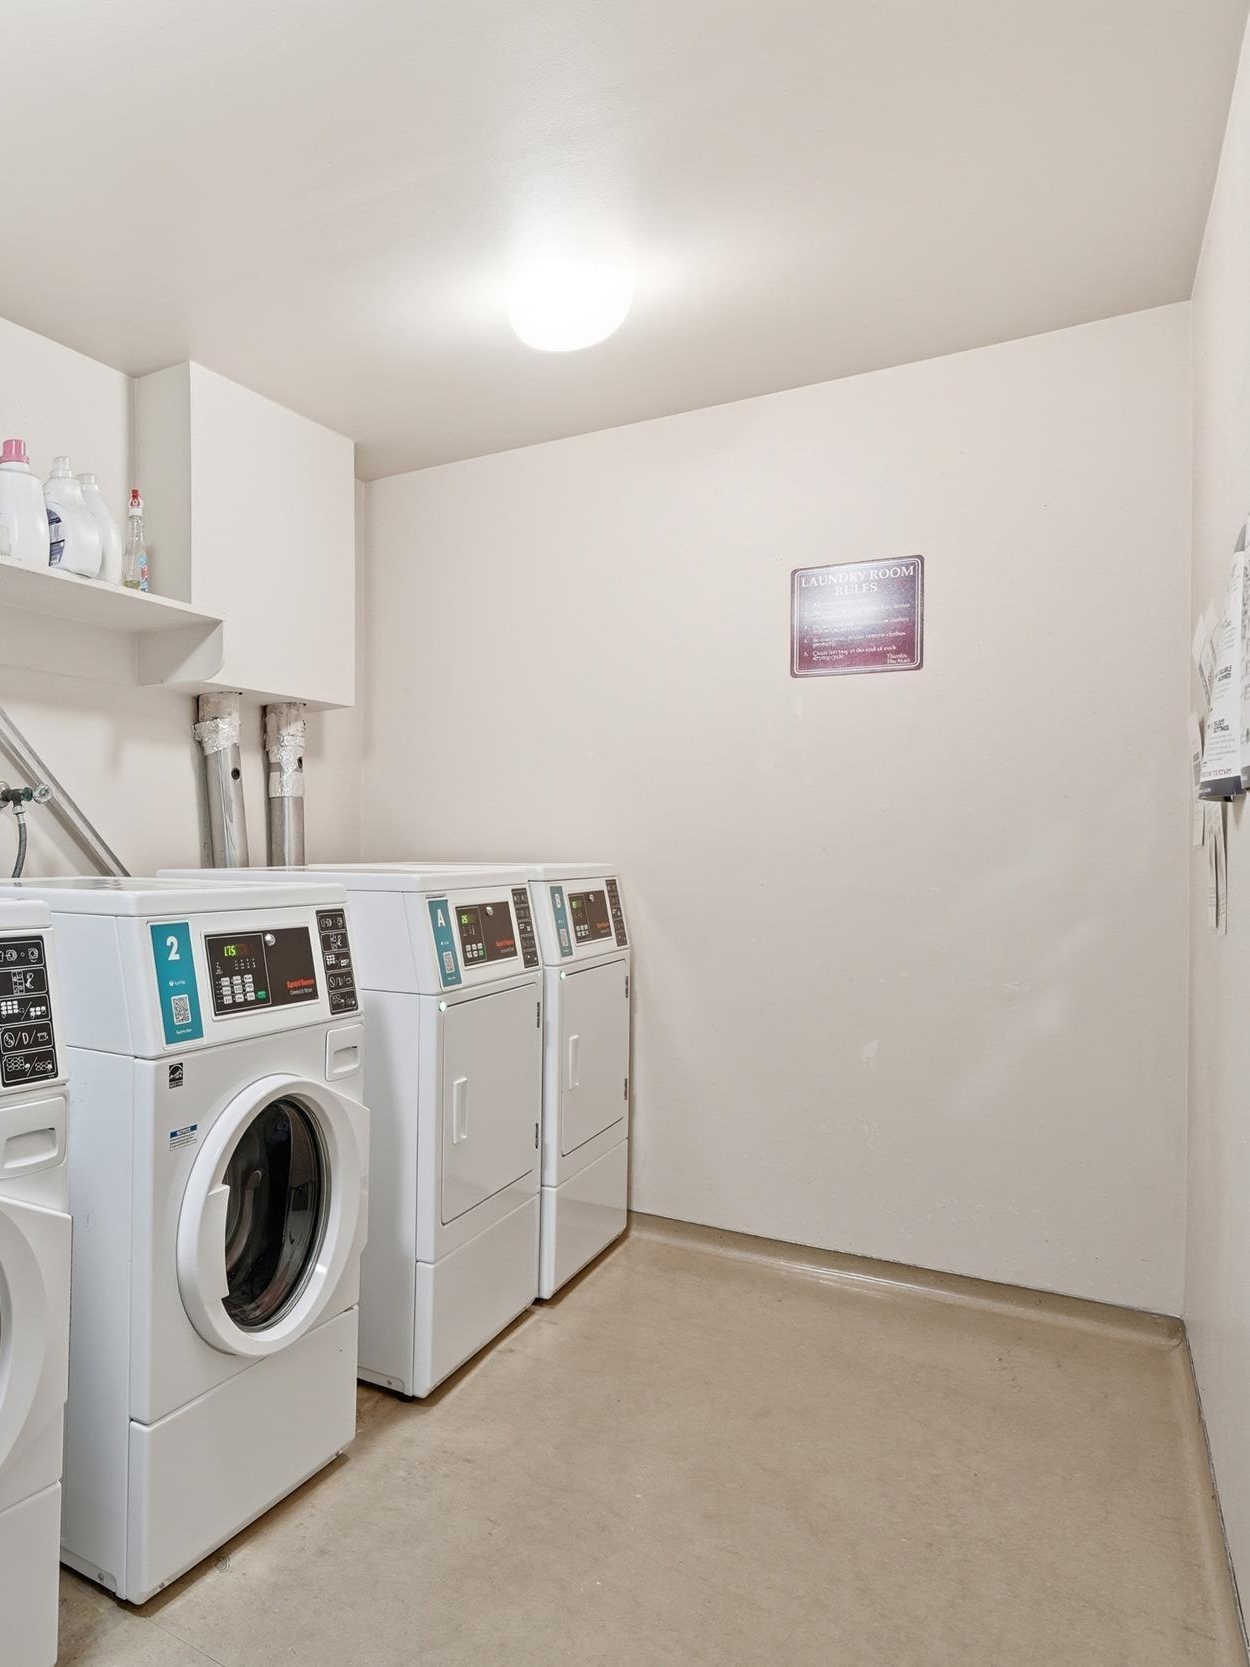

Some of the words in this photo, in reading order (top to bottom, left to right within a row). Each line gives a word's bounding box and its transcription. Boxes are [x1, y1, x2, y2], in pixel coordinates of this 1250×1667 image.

[802, 571, 866, 587] LAUNDRY
[870, 566, 914, 580] ROOM
[836, 582, 878, 596] RULES
[437, 908, 446, 927] A
[166, 936, 180, 960] 2
